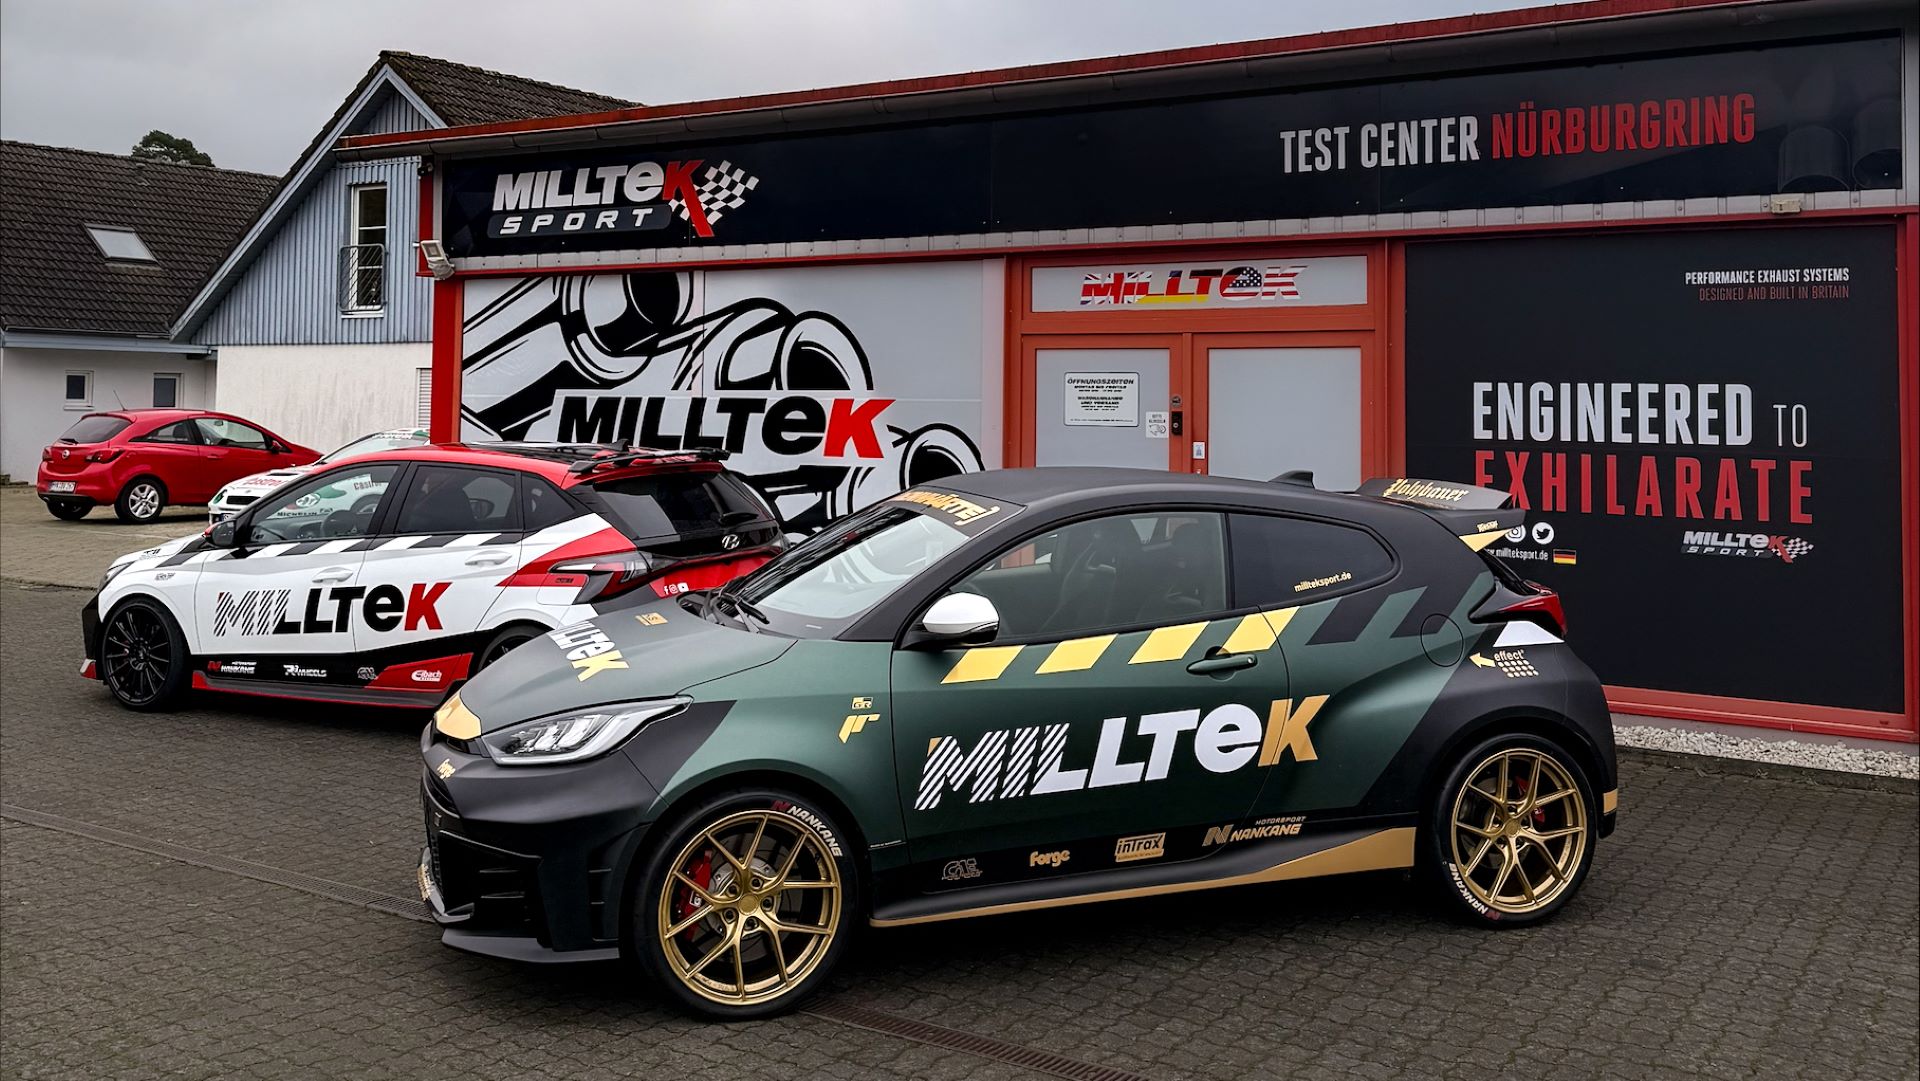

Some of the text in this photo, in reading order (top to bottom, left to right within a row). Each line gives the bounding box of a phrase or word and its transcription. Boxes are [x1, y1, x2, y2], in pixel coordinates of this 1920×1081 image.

[1280, 93, 1755, 174] TEST CENTER NÜRBURGRING
[499, 208, 653, 235] SPORT
[1685, 267, 1850, 285] PERFORMANCE EXHAUST SYSTEMS
[1699, 285, 1849, 301] DESIGNED AND BUILT IN BRITAIN
[1473, 381, 1807, 448] ENGINEERED TO
[1475, 450, 1813, 524] EXHILARATE
[1487, 548, 1549, 561] w.millteksport.de
[1687, 545, 1764, 557] SPORT
[1294, 572, 1352, 592] millteksport.de
[1255, 816, 1306, 825] MOTORSPORT
[787, 805, 843, 857] NANKANG
[1230, 823, 1302, 842] NANKANG
[1448, 862, 1489, 914] NANKANG
